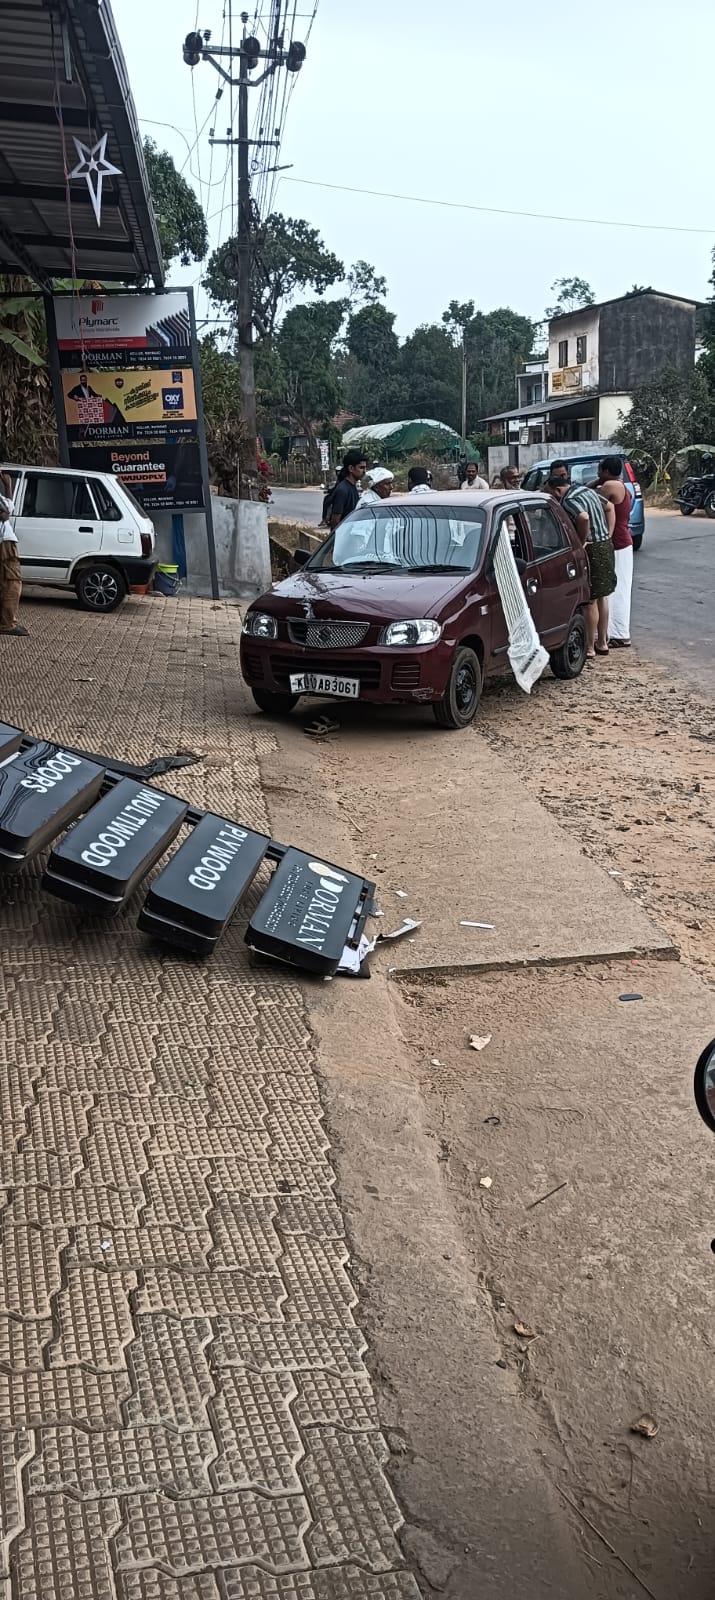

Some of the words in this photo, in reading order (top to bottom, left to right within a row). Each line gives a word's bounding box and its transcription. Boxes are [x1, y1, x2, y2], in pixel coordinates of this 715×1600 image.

[79, 317, 119, 327] Plymarc
[81, 352, 122, 361] DORMAN
[165, 394, 180, 402] OXY
[88, 426, 129, 435] DORMAN
[111, 450, 150, 462] Beyond
[112, 462, 166, 472] Guarantee
[20, 750, 82, 794] DOORS
[81, 789, 166, 867] MULTIWOOD
[188, 823, 248, 891] PLYWOOD
[296, 876, 344, 951] DORMAN
